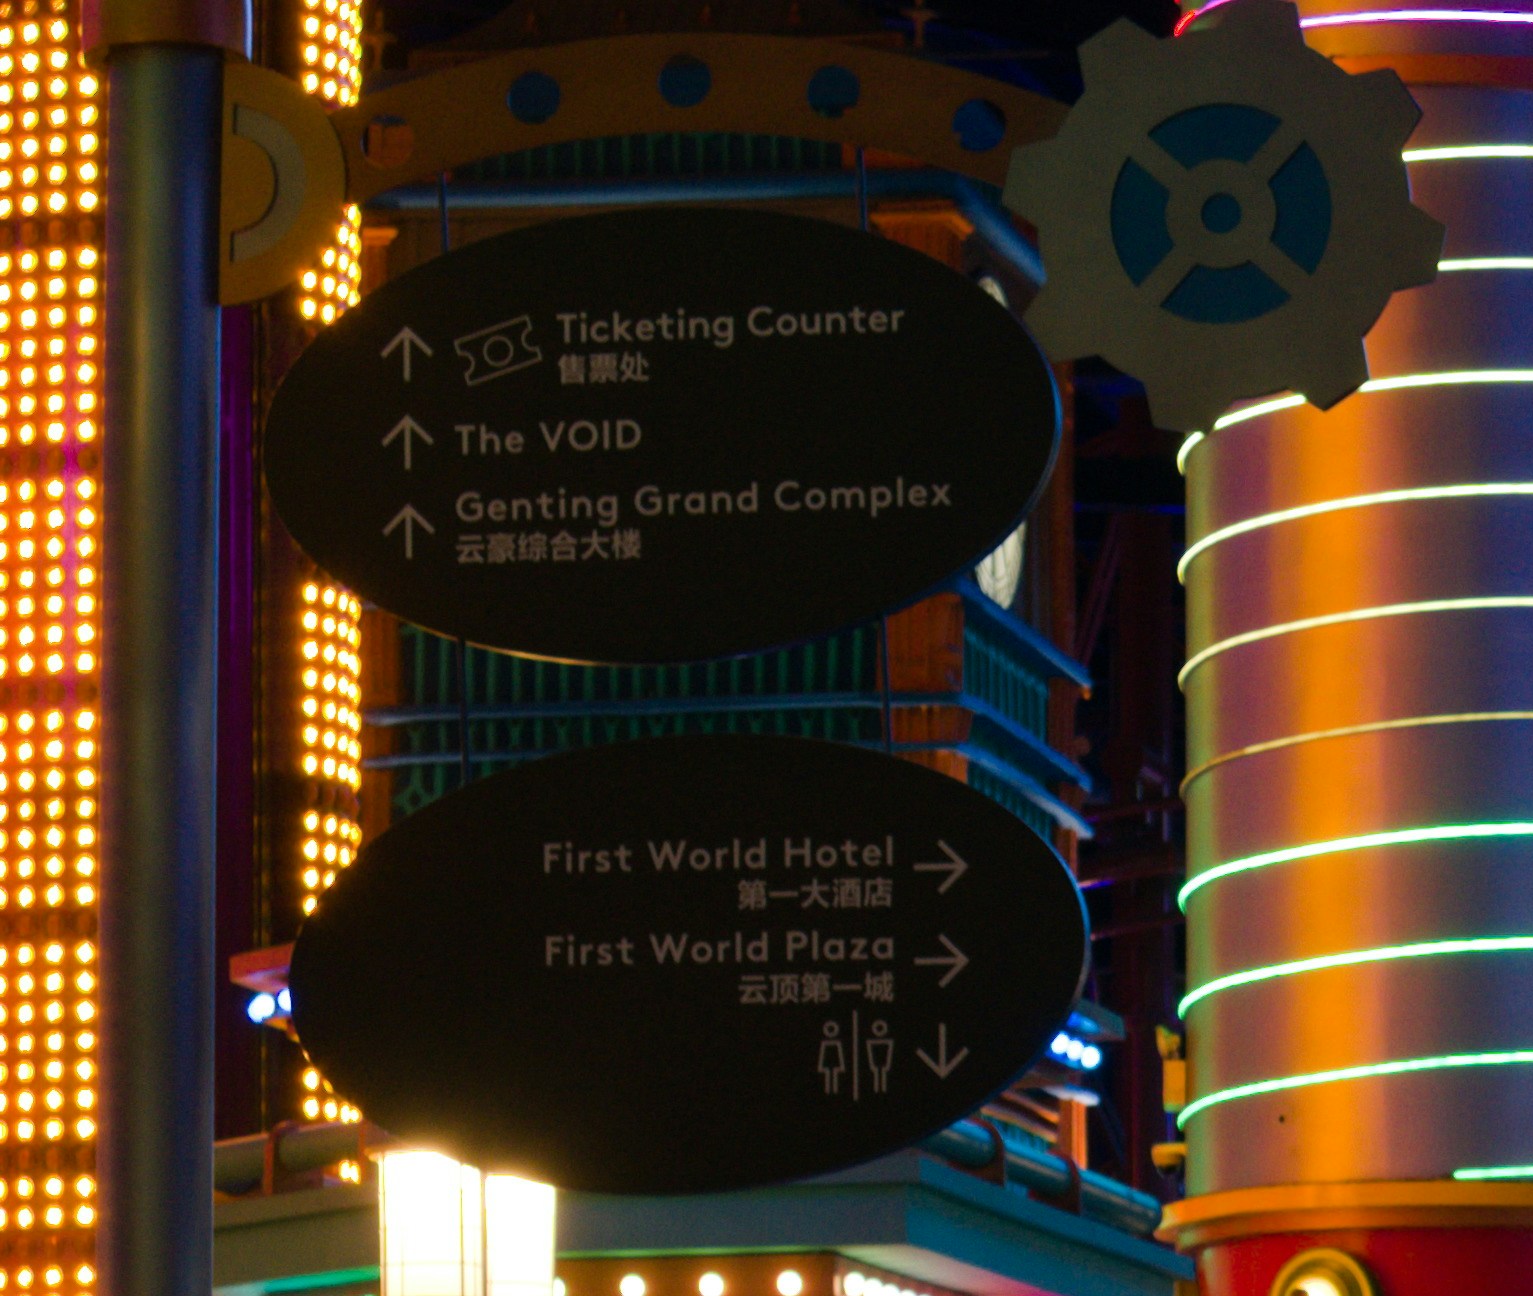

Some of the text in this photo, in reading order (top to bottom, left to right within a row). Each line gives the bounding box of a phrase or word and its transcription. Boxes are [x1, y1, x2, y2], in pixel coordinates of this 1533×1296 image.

[556, 305, 905, 348] Ticketing Counter
[557, 352, 650, 385] 售票处
[454, 419, 642, 455] The VOID
[455, 476, 951, 527] Genting Grand Complex
[455, 527, 642, 564] 云豪综合大楼
[543, 835, 894, 874] First World Hotel
[737, 877, 893, 909] 第一大酒店
[545, 930, 894, 966] First World Plaza
[738, 972, 895, 1004] 云顶第一城
